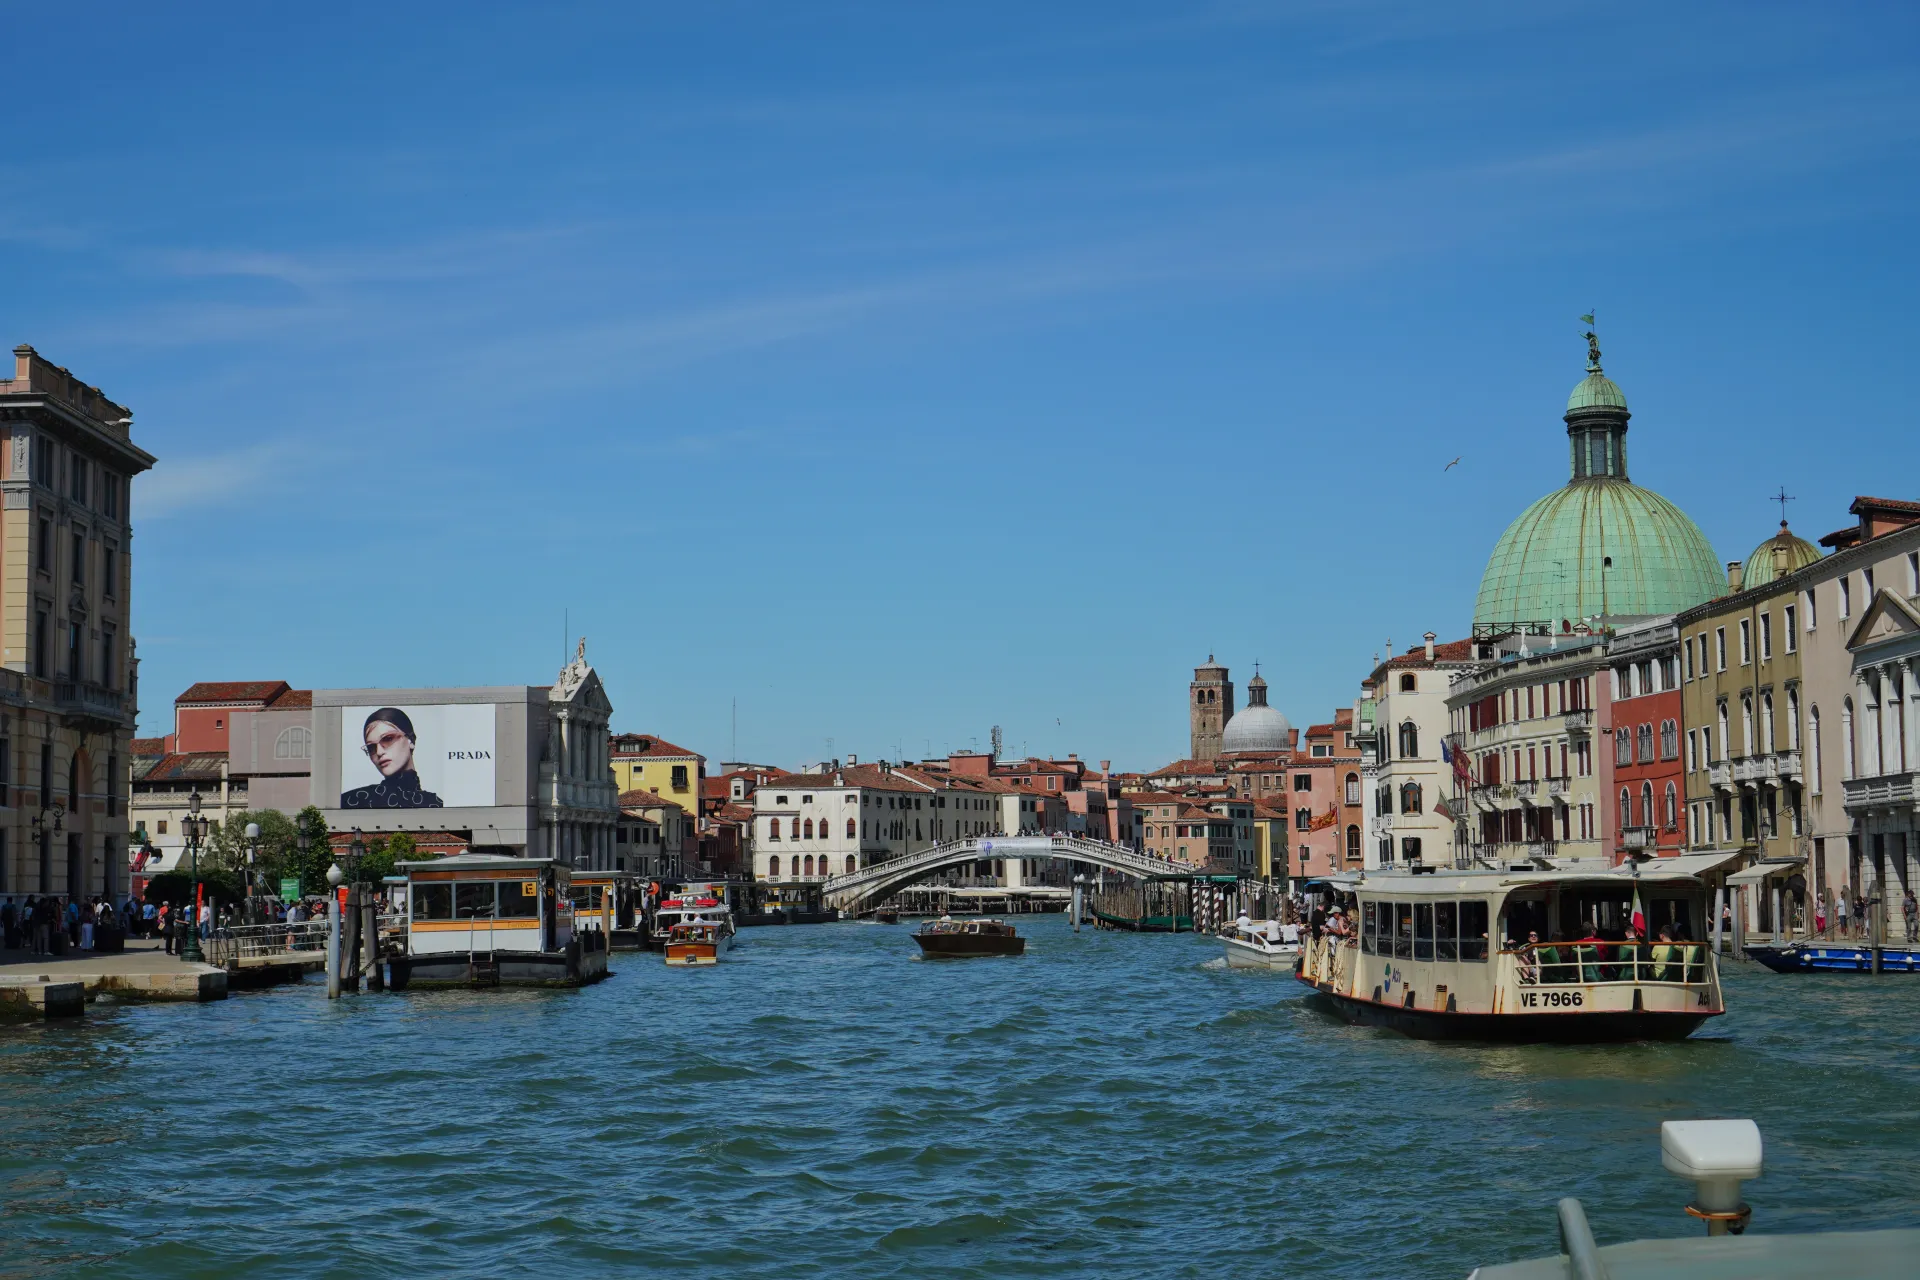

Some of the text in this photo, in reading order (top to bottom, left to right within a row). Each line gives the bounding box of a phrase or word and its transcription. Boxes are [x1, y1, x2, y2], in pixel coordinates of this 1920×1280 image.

[448, 751, 491, 760] PRADA
[1521, 992, 1583, 1007] VE 7966
